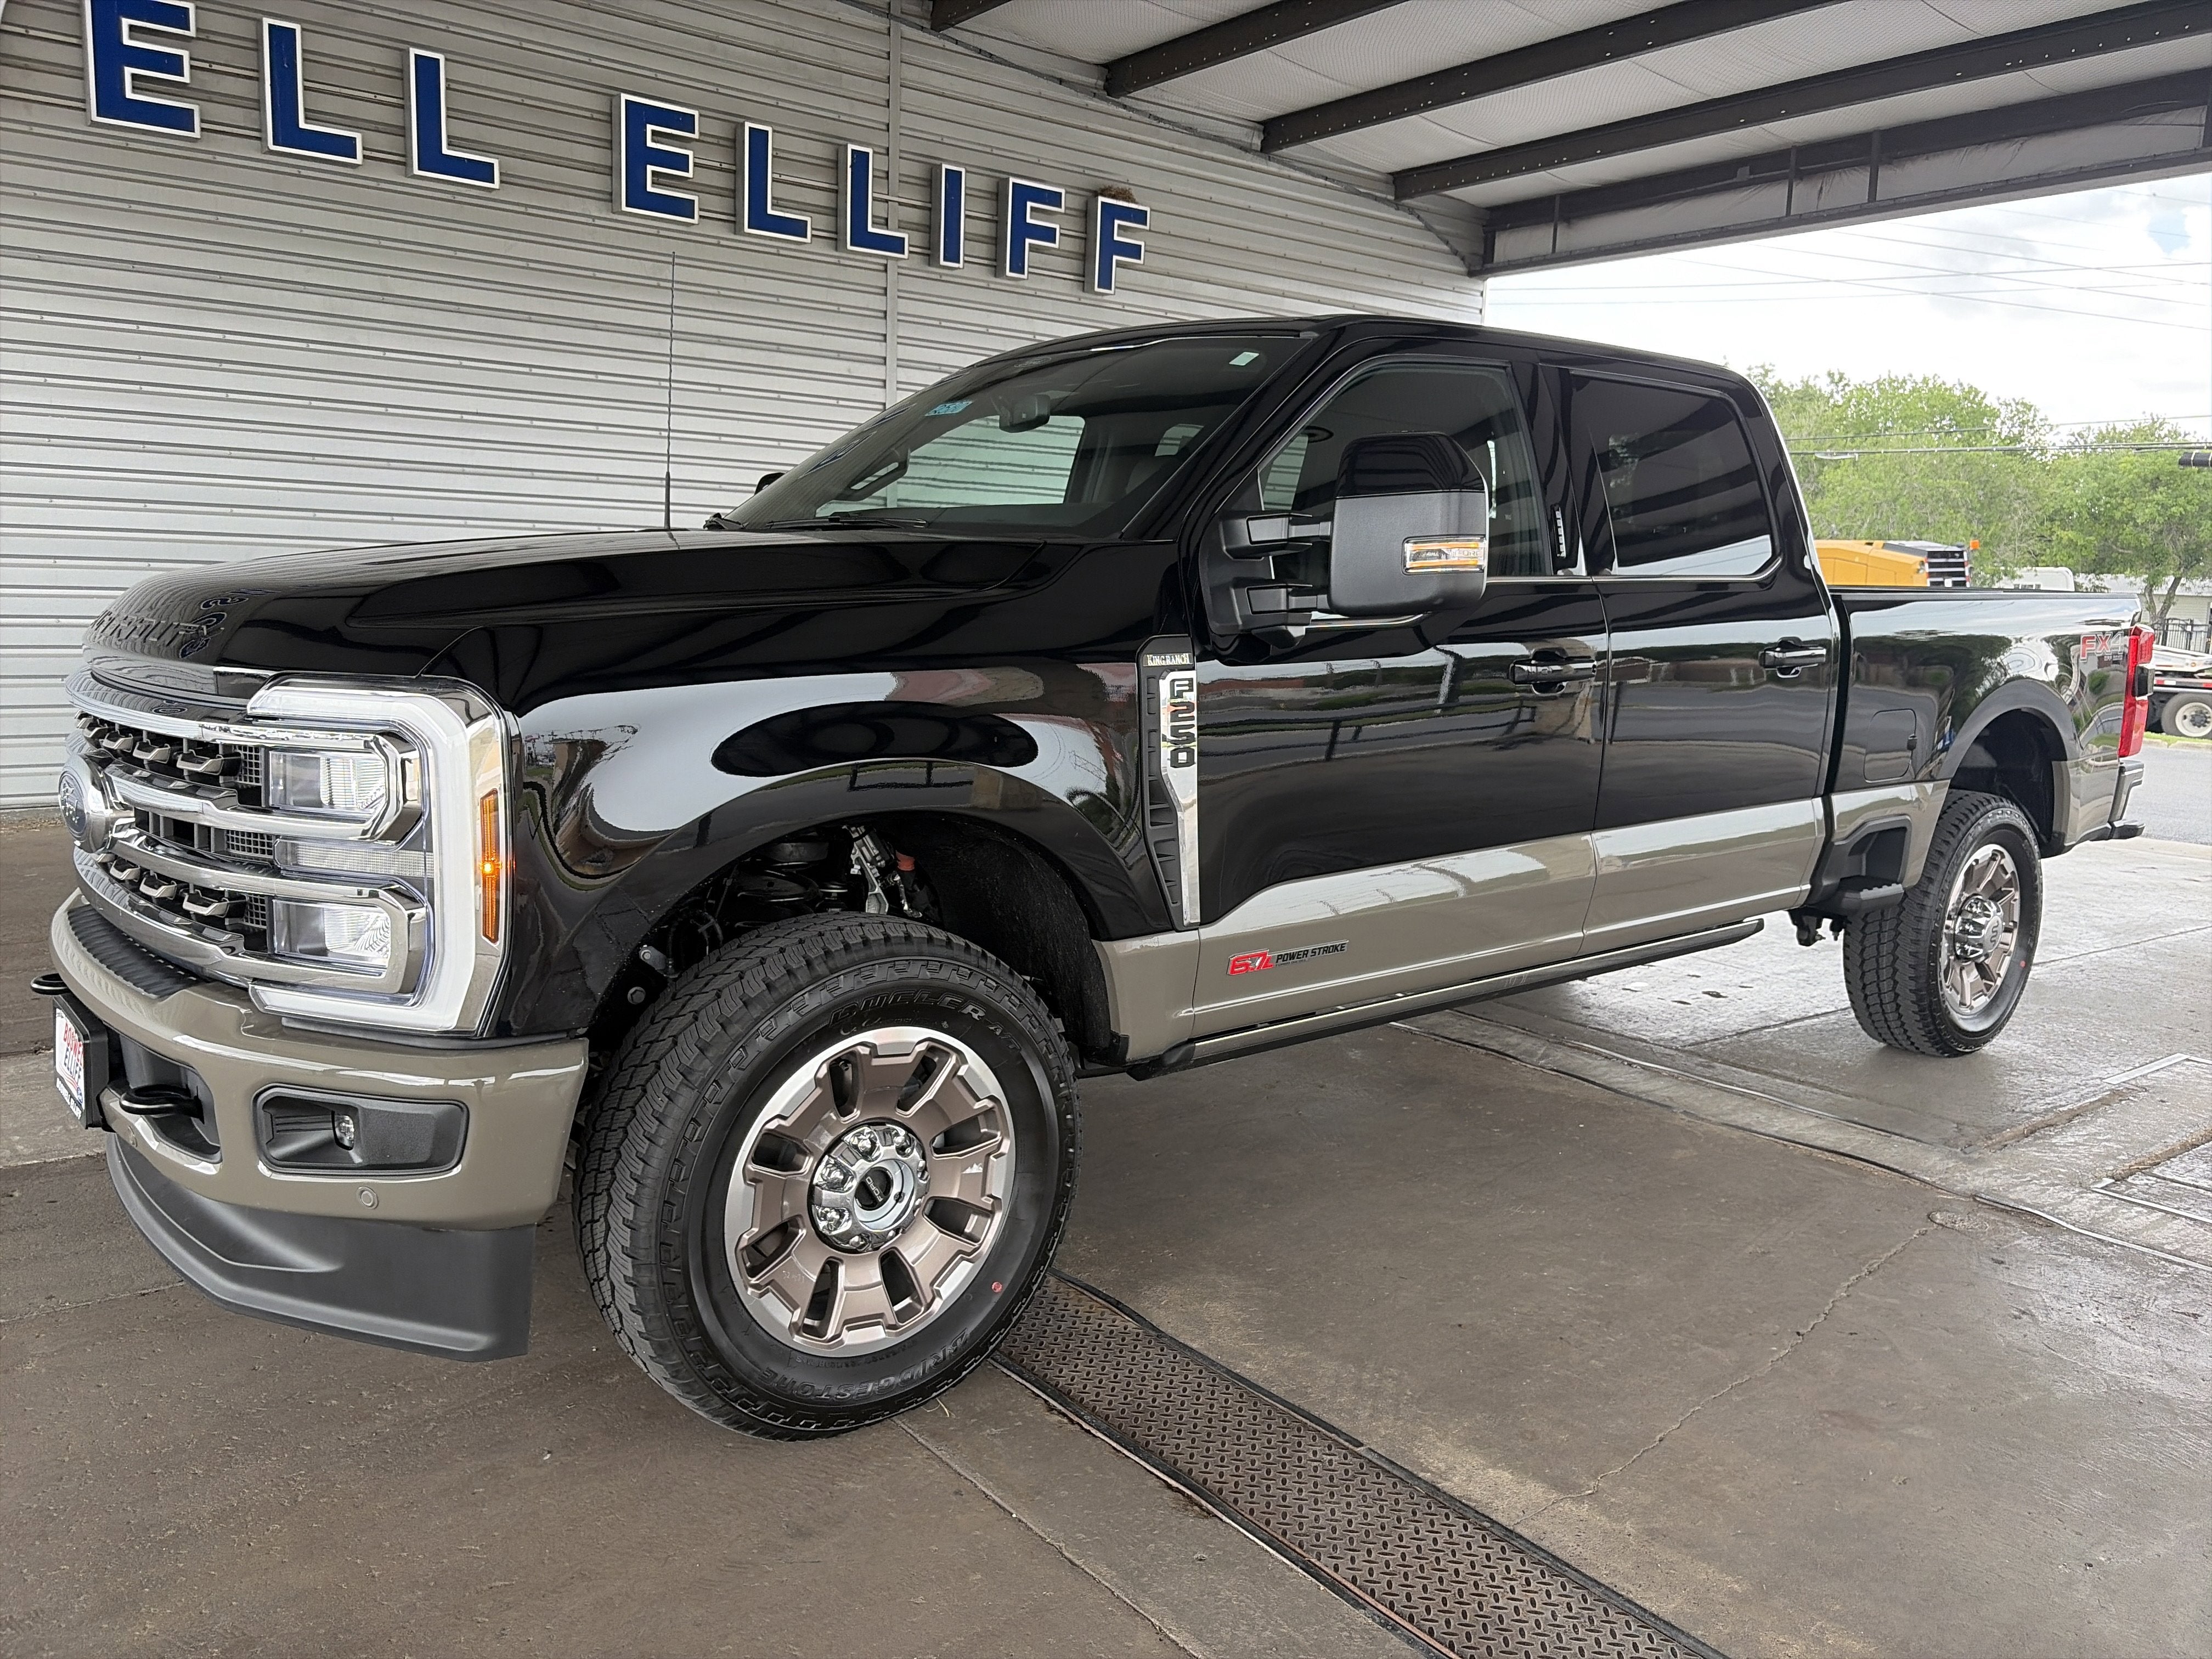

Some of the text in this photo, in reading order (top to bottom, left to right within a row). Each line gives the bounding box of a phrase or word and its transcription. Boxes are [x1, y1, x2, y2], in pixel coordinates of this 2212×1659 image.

[611, 91, 1151, 295] ELLIFF
[1147, 653, 1190, 667] KING RANCH
[2079, 631, 2124, 663] FX4
[1169, 678, 1195, 769] F250
[1228, 943, 1347, 975] 6.7L POWER STROKE
[987, 1022, 1022, 1051] A/T
[64, 1046, 82, 1086] ELLIFF
[865, 1176, 884, 1202] FORD
[759, 1327, 970, 1401] BRIDGESTONE
